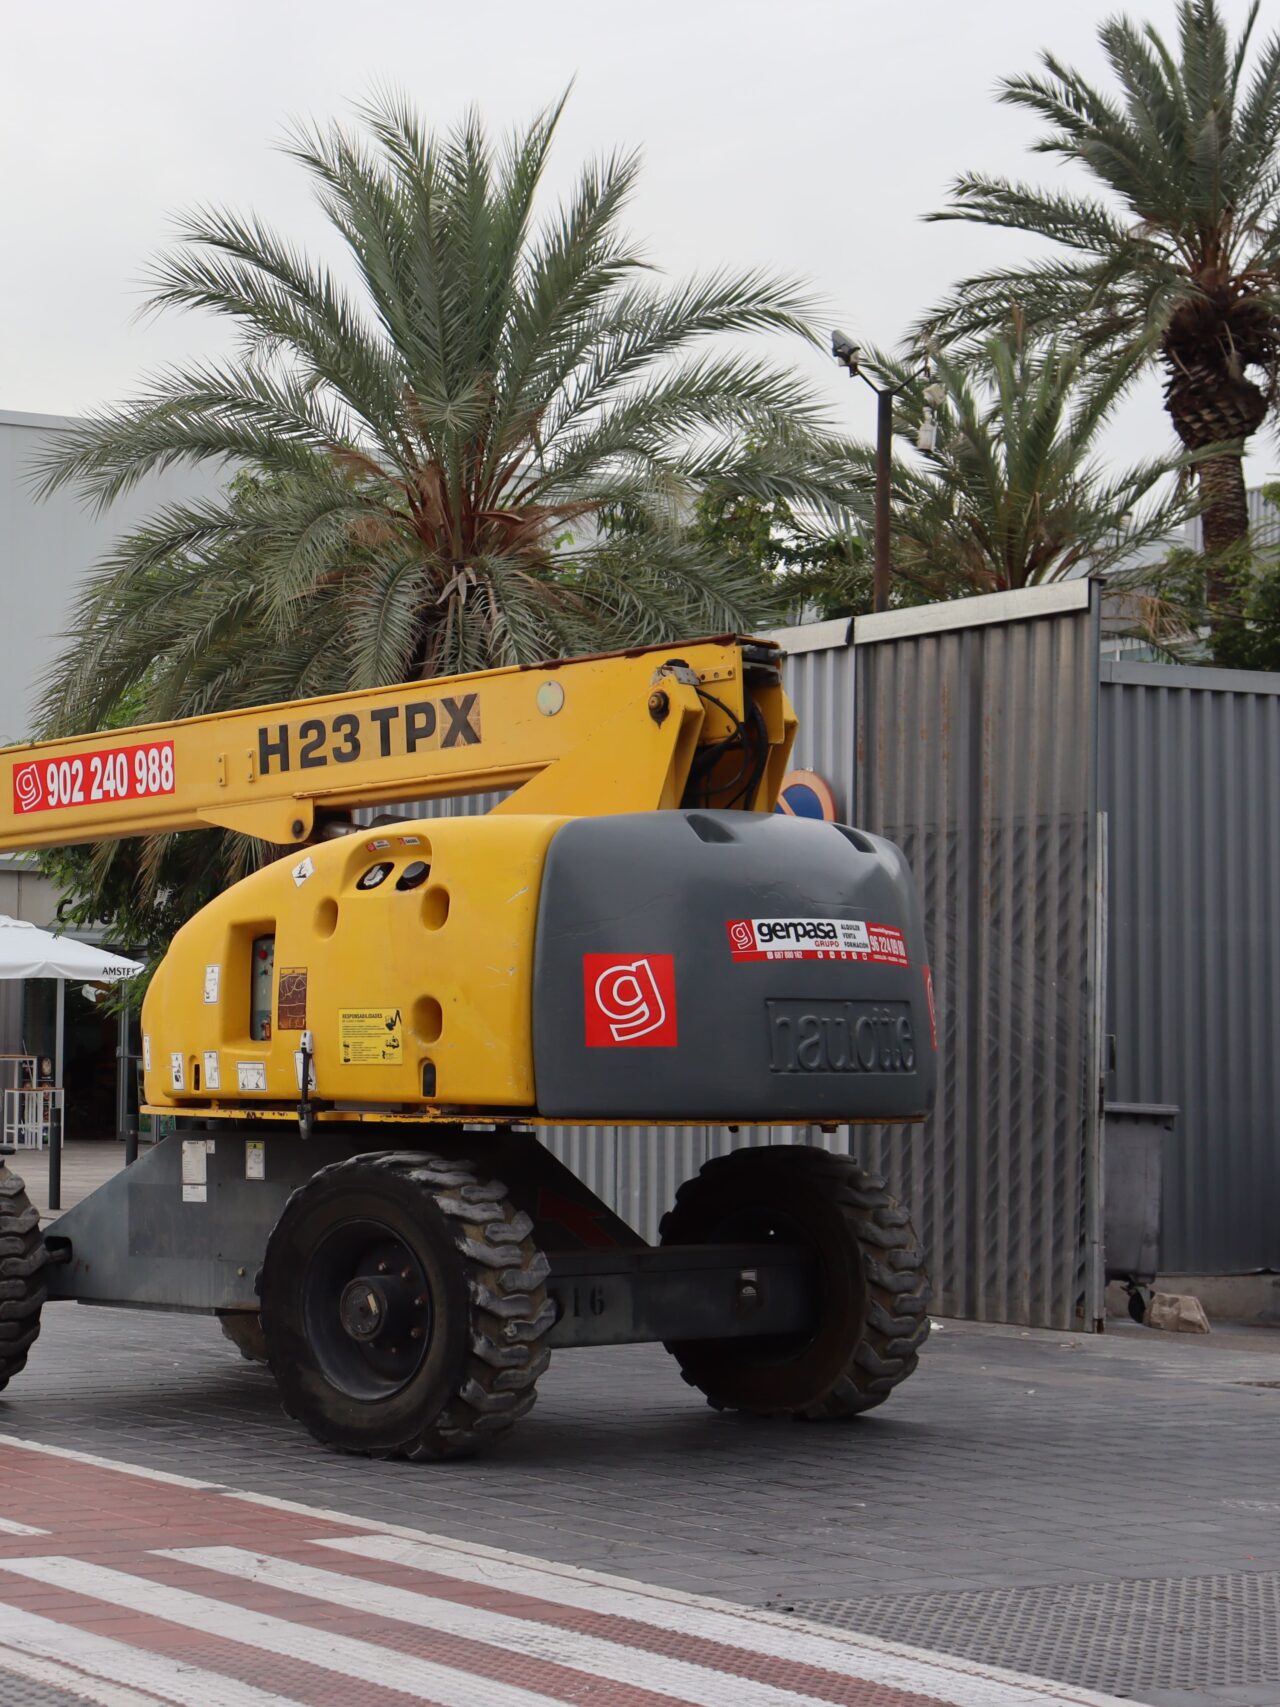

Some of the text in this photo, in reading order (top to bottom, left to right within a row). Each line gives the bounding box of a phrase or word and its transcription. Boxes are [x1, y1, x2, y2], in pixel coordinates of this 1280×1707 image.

[370, 693, 481, 757] TPX
[46, 759, 84, 806] 902
[90, 752, 129, 800] 240
[134, 746, 174, 794] 988
[757, 922, 838, 942] gerpasa
